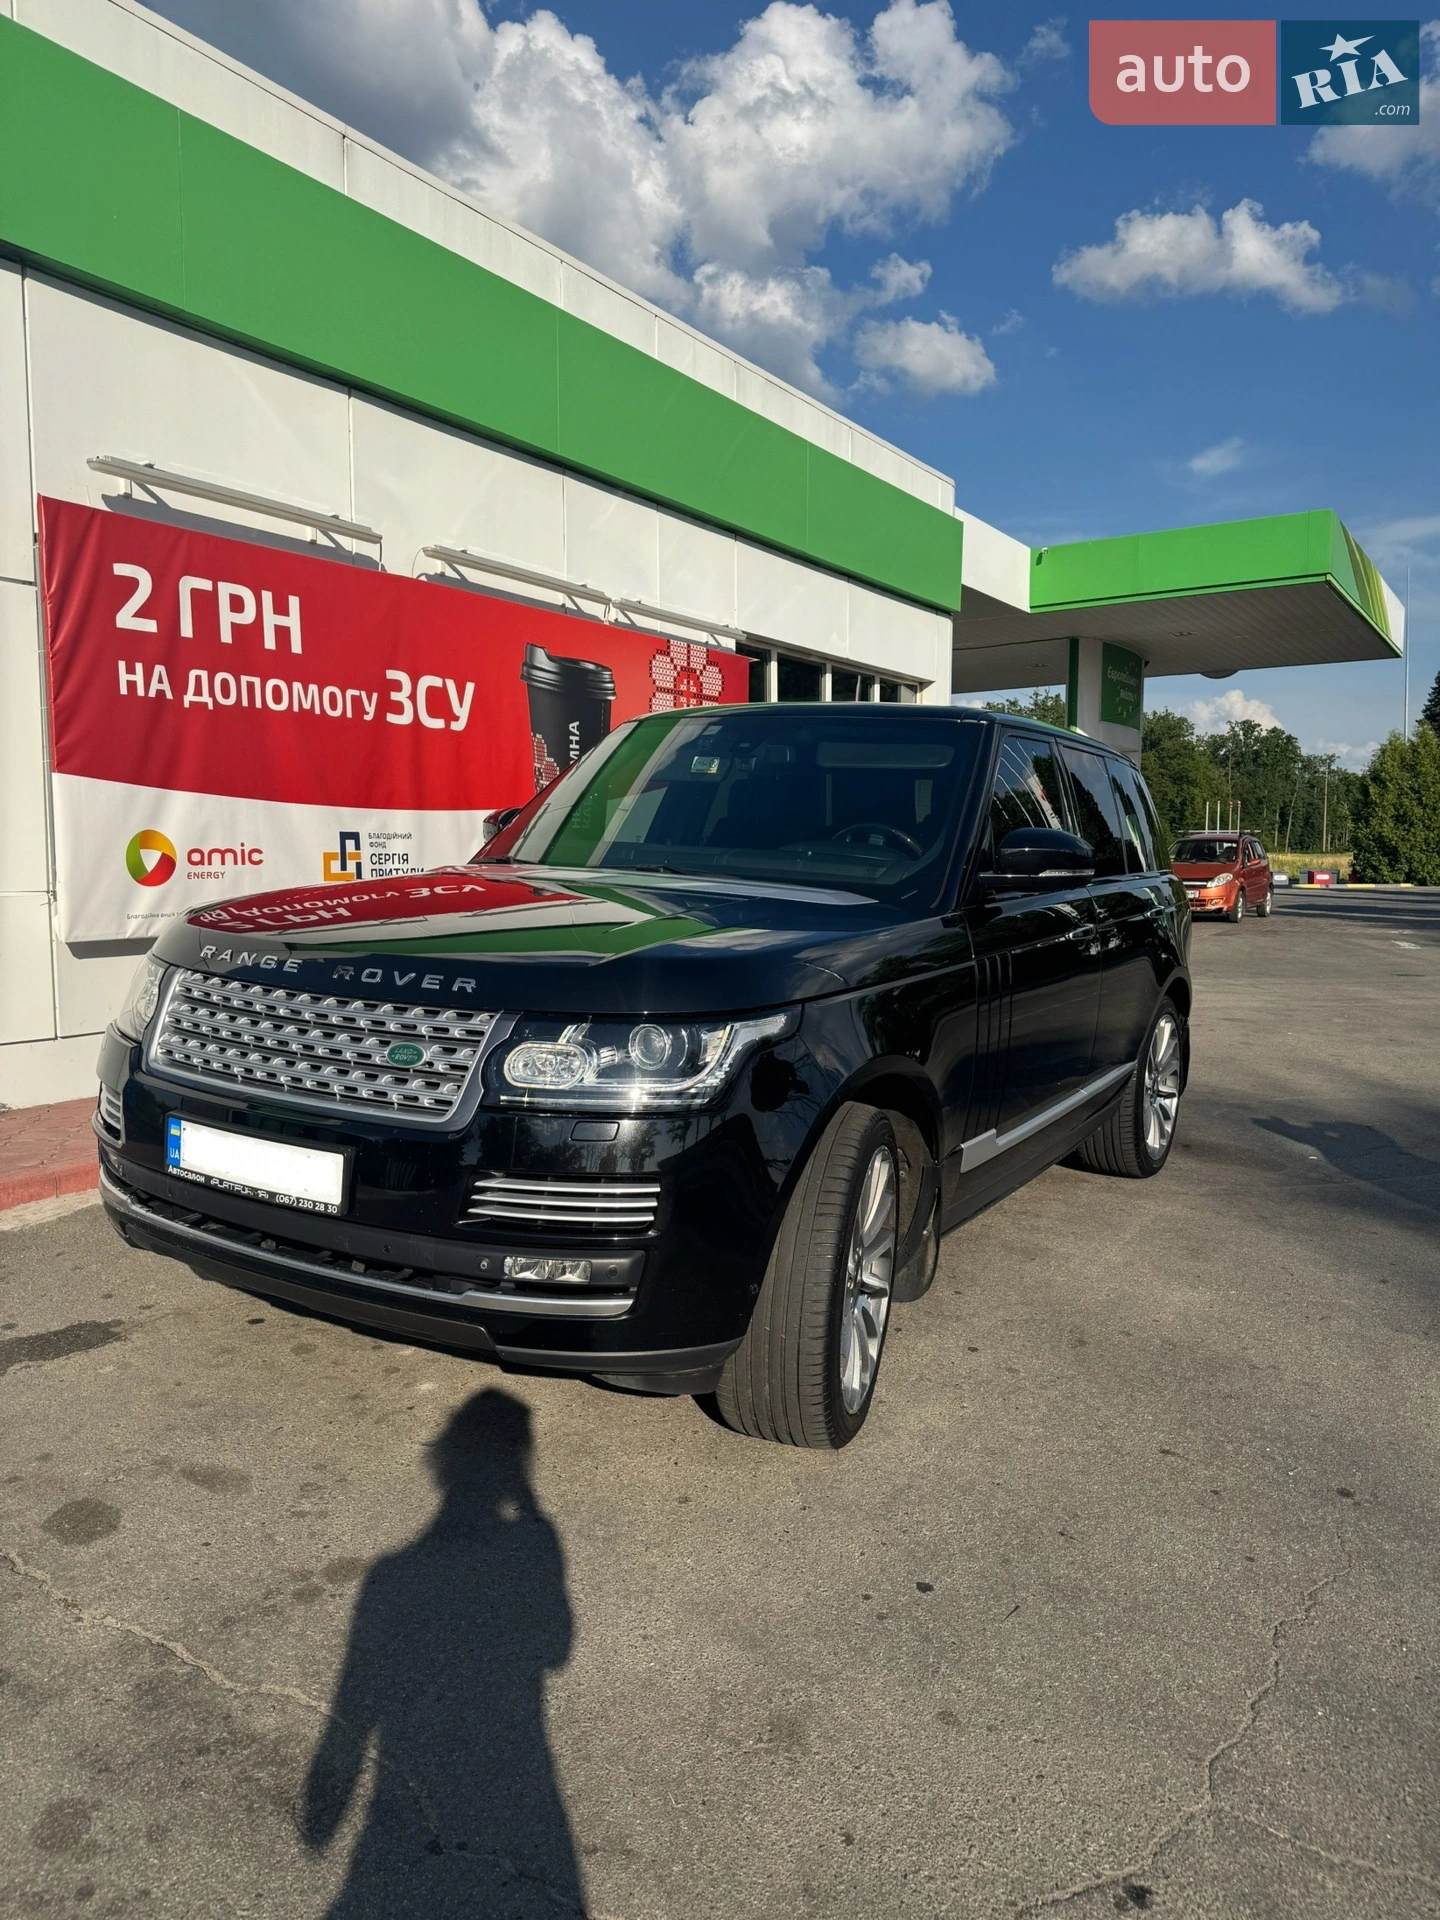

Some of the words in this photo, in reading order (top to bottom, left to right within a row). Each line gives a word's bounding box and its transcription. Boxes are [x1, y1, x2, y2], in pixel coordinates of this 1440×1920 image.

[112, 562, 158, 633] 2
[178, 574, 303, 655] ГРН
[117, 659, 174, 700] НА
[183, 668, 379, 721] ДОПОМОГУ
[385, 669, 475, 731] ЗСУ
[368, 832, 412, 840] БЛАГОДІЙНИЙ
[369, 841, 387, 849] ФОНД
[186, 841, 264, 866] amic
[370, 853, 409, 865] СЕРГІЯ
[186, 871, 226, 880] ENERGY
[200, 945, 303, 973] RANGE
[332, 965, 477, 993] ROVER
[394, 1047, 414, 1055] LAND
[394, 1053, 418, 1062] ROVER
[169, 1147, 180, 1160] UA
[168, 1164, 205, 1183] Автосалон
[275, 1194, 298, 1207] (067)
[298, 1198, 314, 1209] 230
[315, 1202, 325, 1212] 28
[327, 1204, 338, 1214] 30
